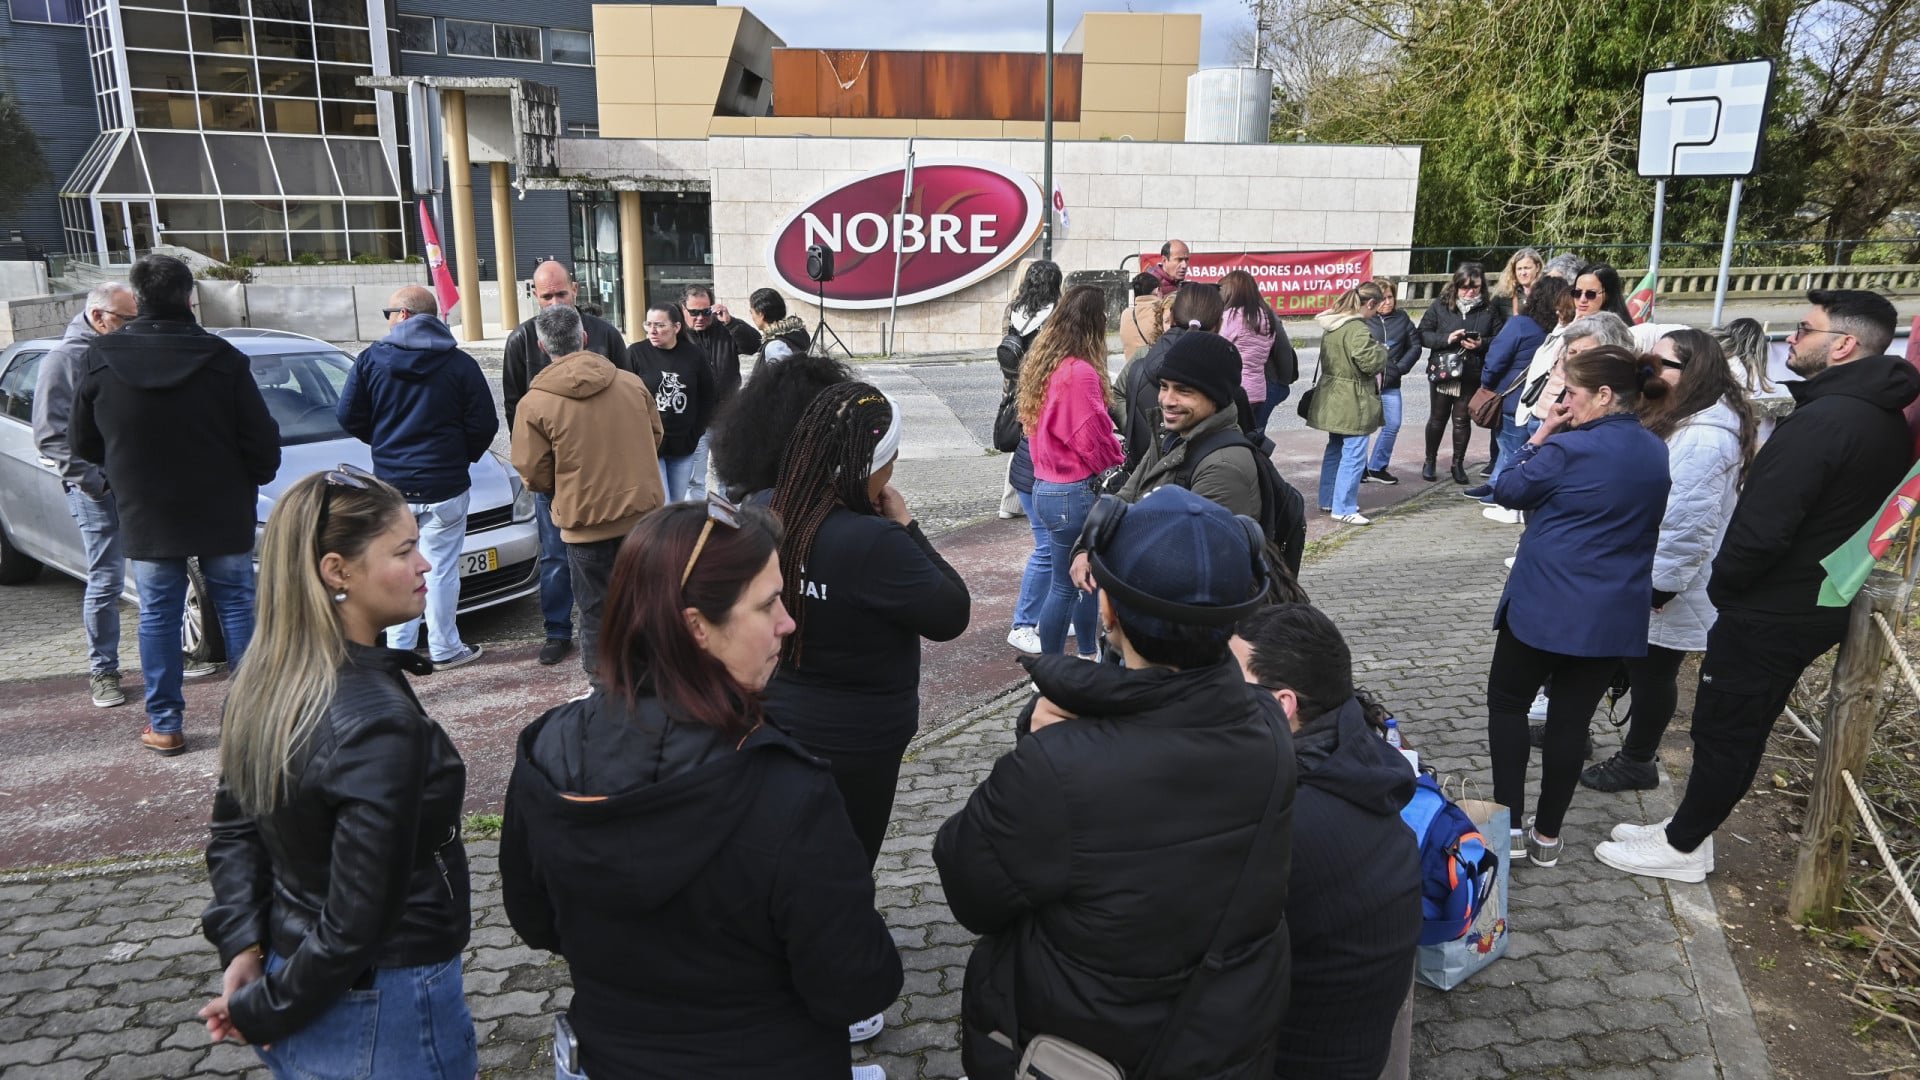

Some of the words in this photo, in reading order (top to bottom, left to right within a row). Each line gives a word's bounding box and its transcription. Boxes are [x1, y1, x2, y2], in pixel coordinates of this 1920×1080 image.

[802, 212, 999, 254] NOBRE
[1294, 264, 1312, 276] DA
[1314, 262, 1362, 275] NOBRE
[1281, 280, 1300, 292] NA
[1303, 279, 1333, 291] LUTA
[1335, 278, 1360, 290] POR
[1277, 296, 1285, 309] E
[1289, 294, 1340, 309] DIREIT
[467, 554, 487, 574] 28
